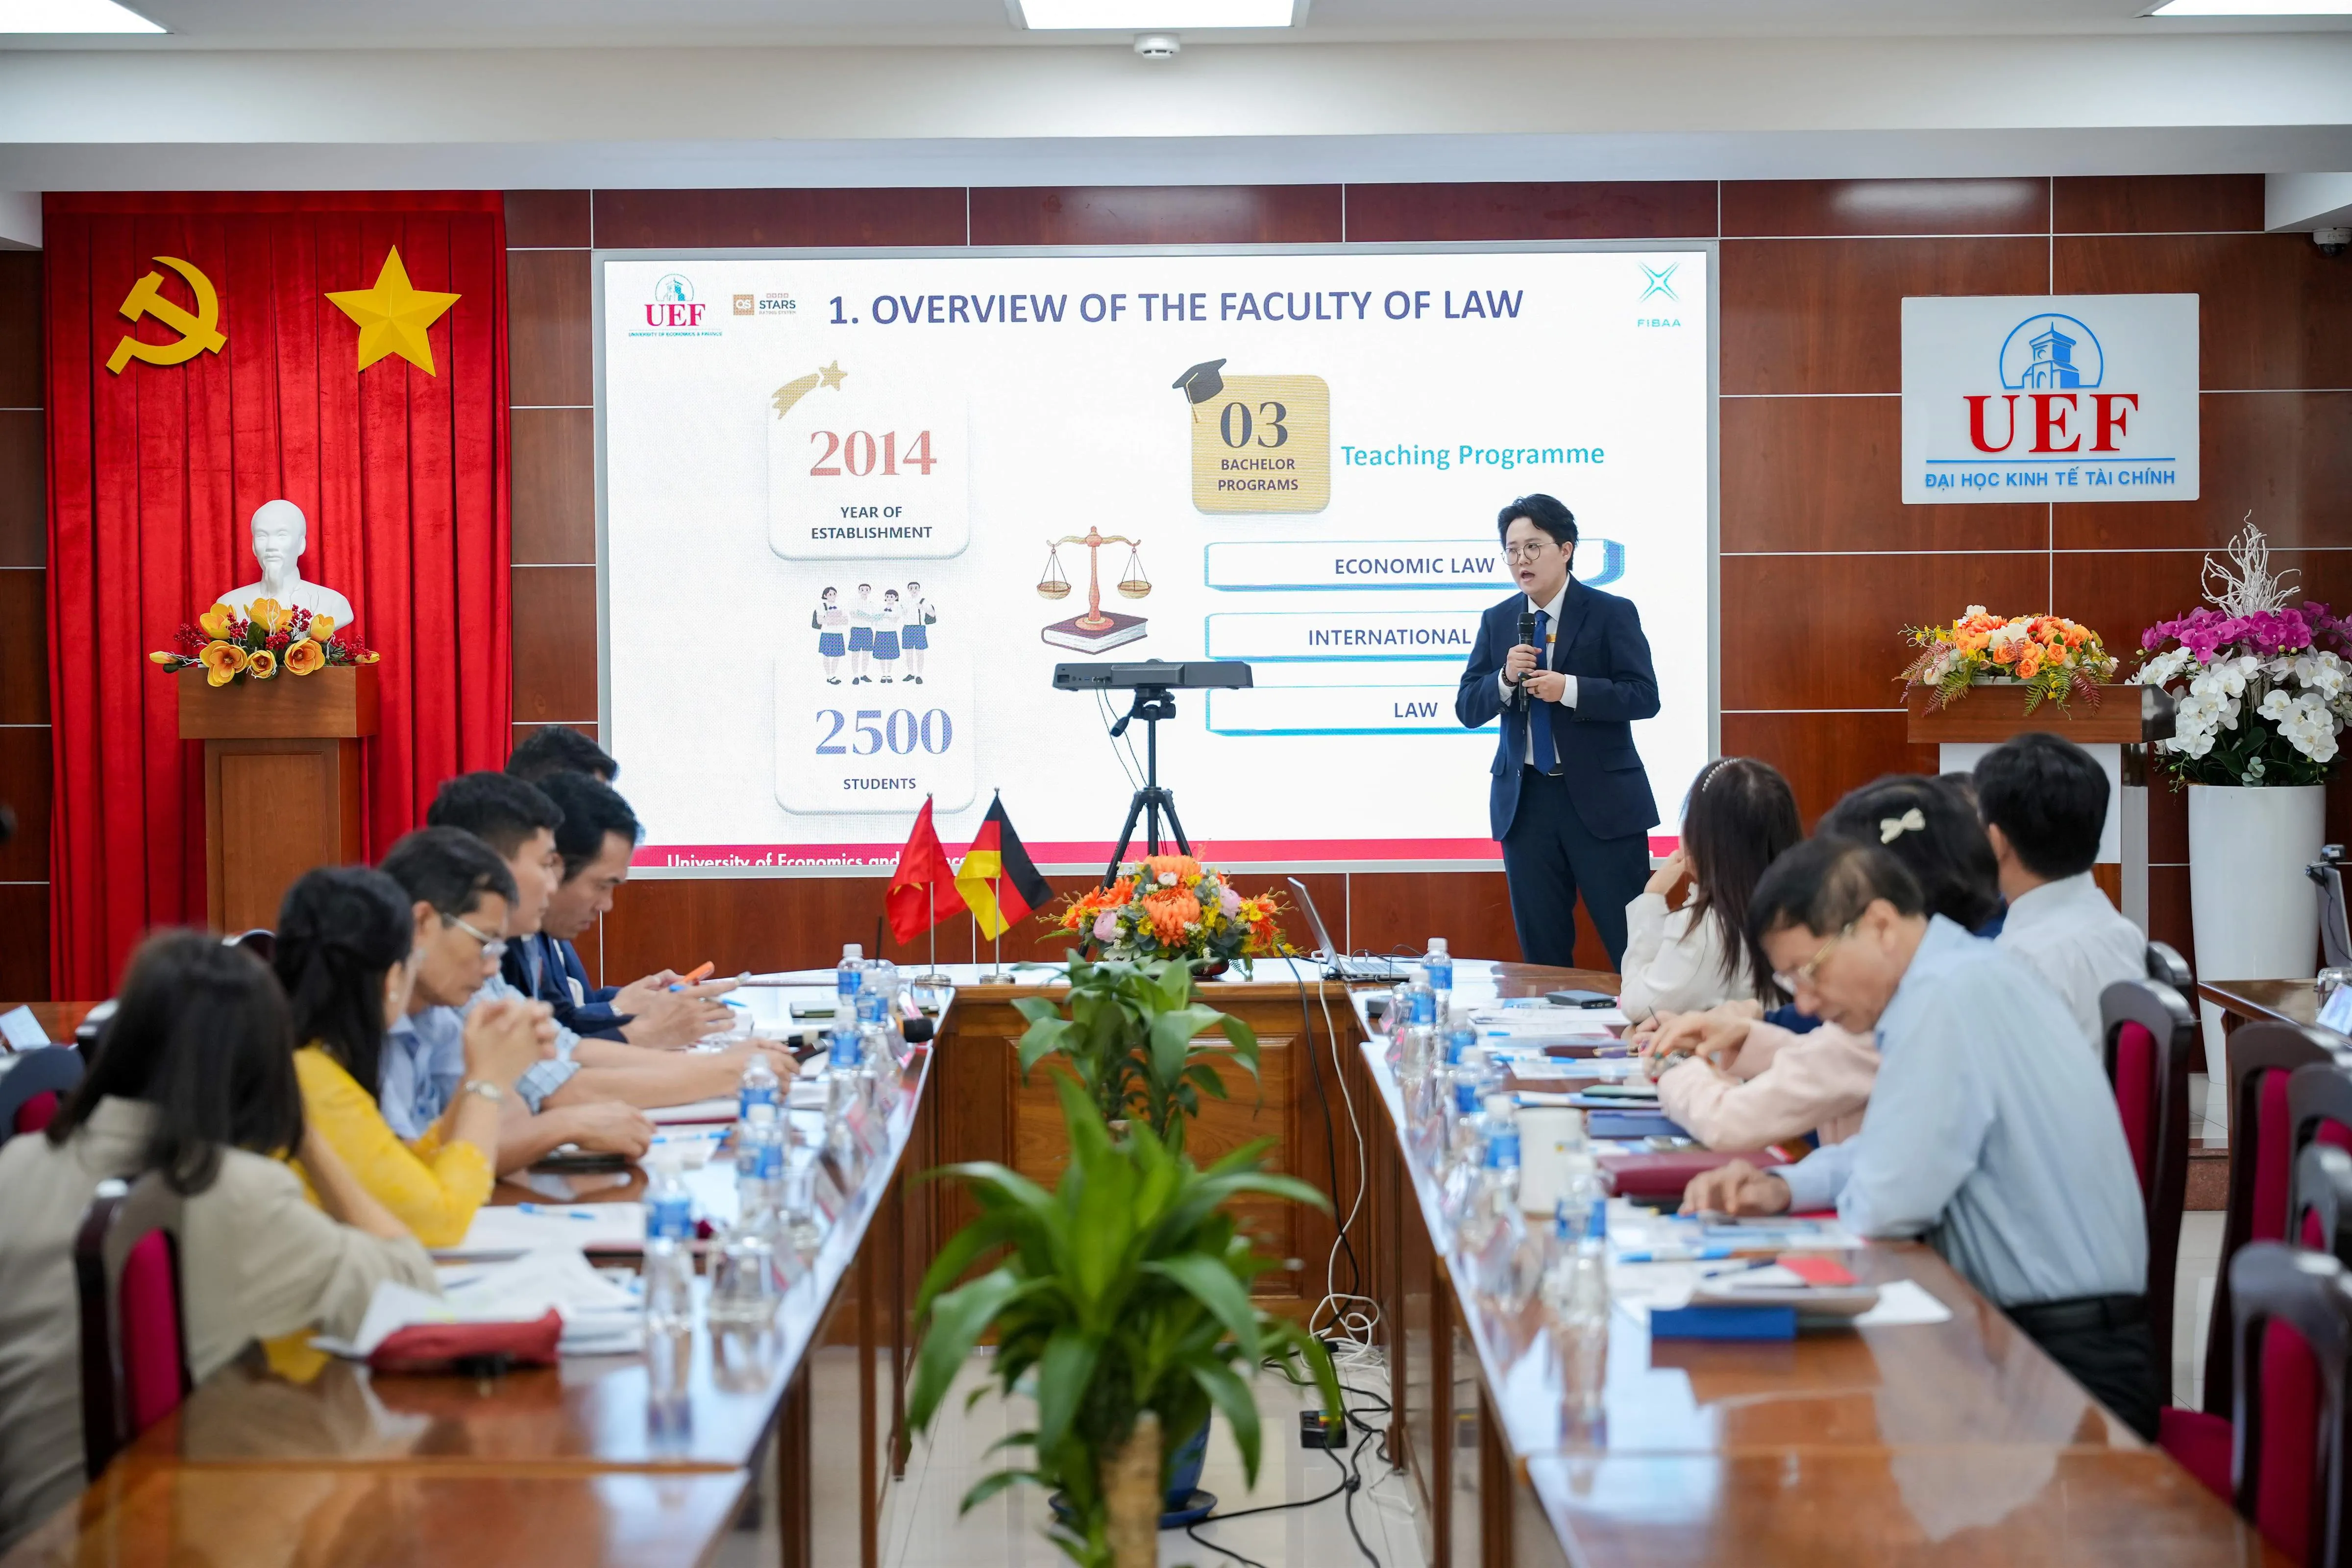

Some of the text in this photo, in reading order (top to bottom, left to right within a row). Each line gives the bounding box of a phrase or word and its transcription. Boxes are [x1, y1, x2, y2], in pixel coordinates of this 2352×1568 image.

[759, 299, 796, 309] STARS
[830, 290, 1523, 324] 1. OVERVIEW OF THE FACULTY OF LAW
[644, 304, 706, 326] UEF
[1637, 318, 1681, 327] FIBAA
[1220, 401, 1288, 449] 03
[1963, 393, 2138, 453] UEF
[810, 430, 937, 476] 2014
[1341, 444, 1604, 470] Teaching Programme
[1221, 458, 1296, 471] BACHELOR
[1218, 479, 1298, 491] PROGRAMS
[1925, 466, 2175, 491] ĐẠI HỌC KINH TẾ TÀI CHÍNH
[840, 506, 902, 518] YEAR OF
[811, 526, 932, 539] ESTABLISHMENT
[1335, 558, 1495, 574] ECONOMIC LAW
[1309, 629, 1471, 645] INTERNATIONAL
[1395, 702, 1438, 718] LAW
[816, 709, 953, 755] 2500
[843, 778, 916, 790] STUDENTS
